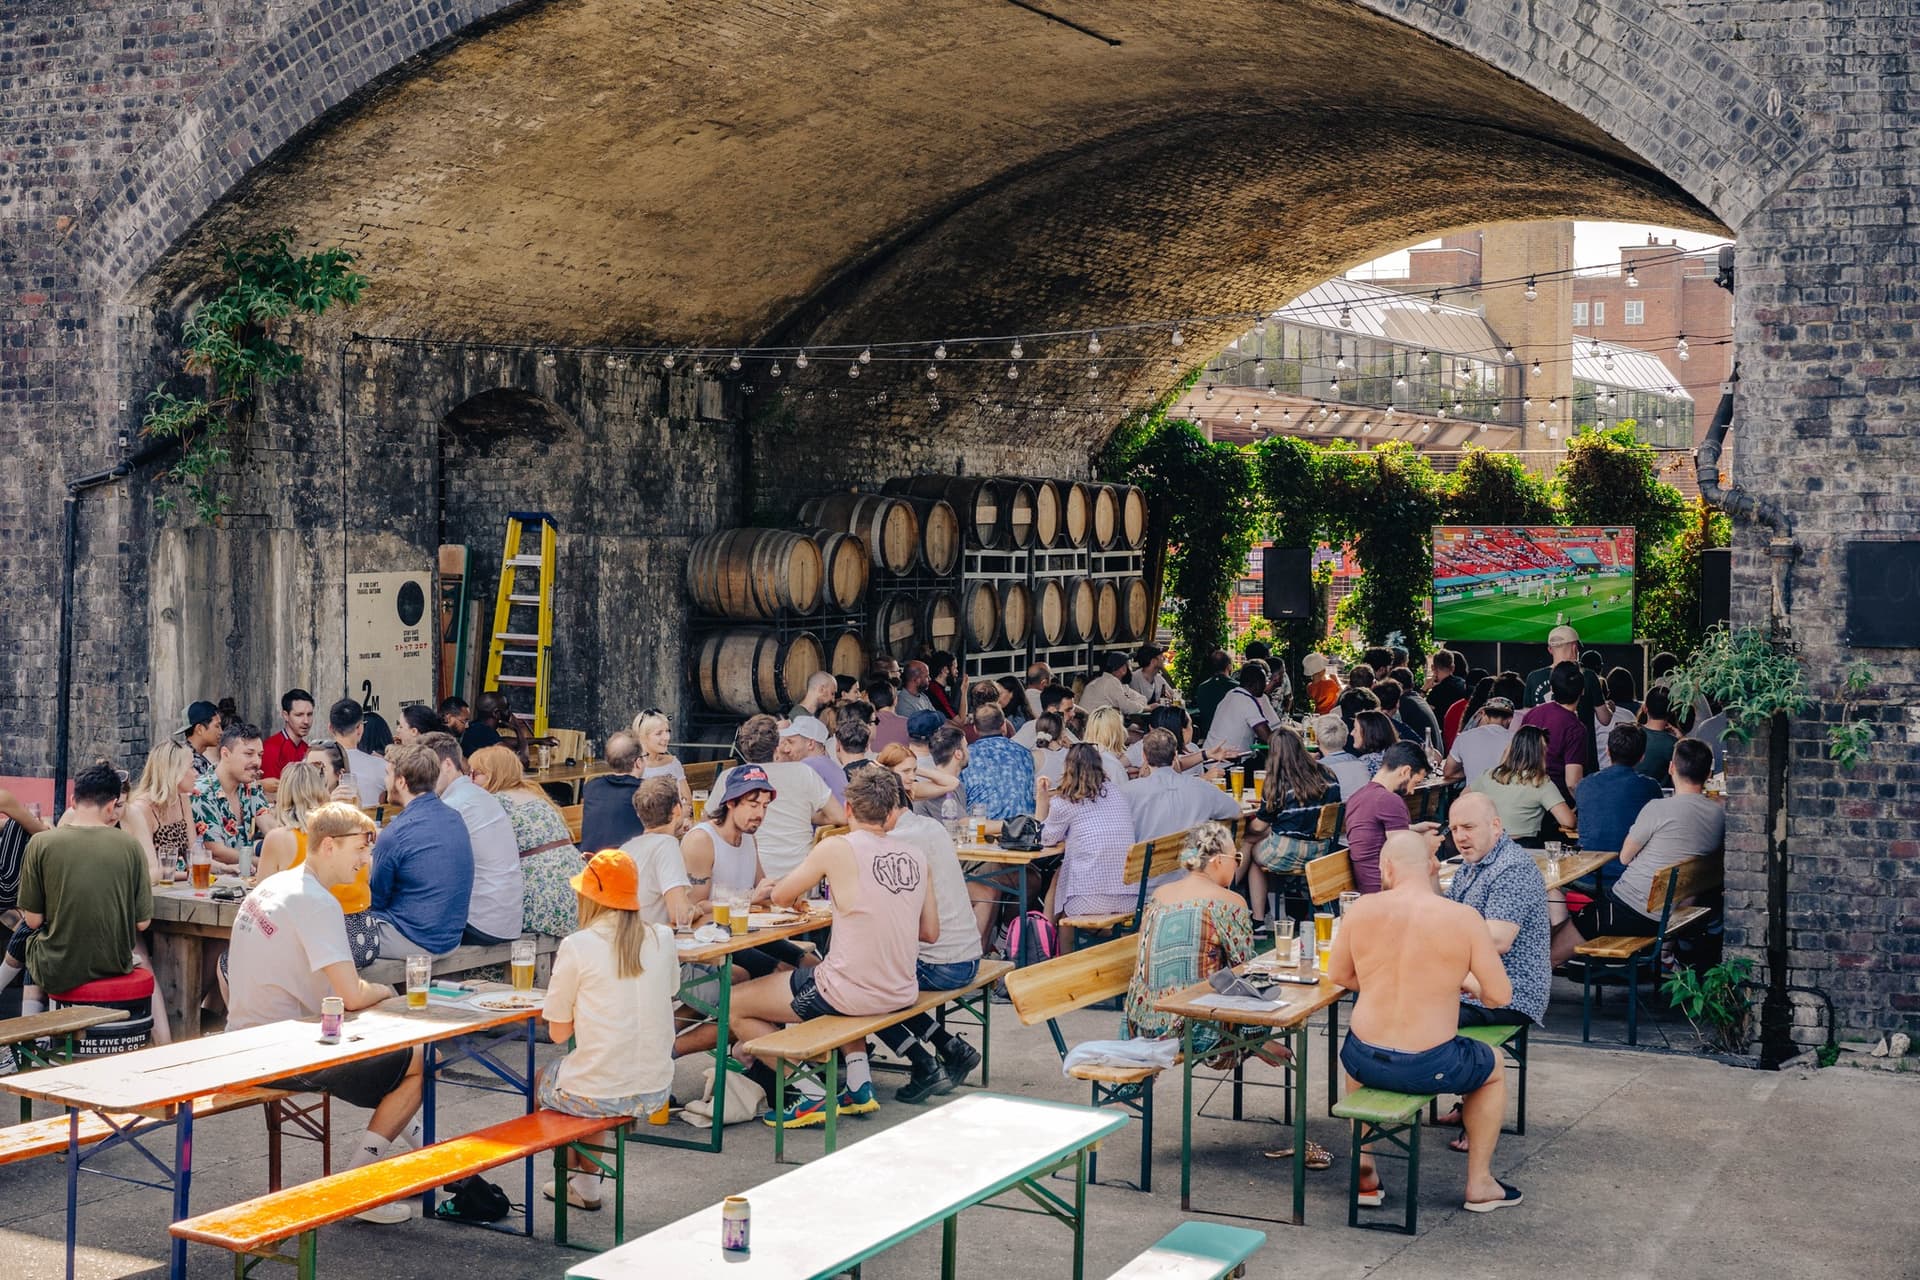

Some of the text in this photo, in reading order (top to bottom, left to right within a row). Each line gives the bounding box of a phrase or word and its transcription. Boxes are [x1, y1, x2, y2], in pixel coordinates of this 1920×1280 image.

[100, 1038, 119, 1046] FIVE
[121, 1034, 146, 1045] POINTS
[80, 1045, 125, 1054] BREWING
